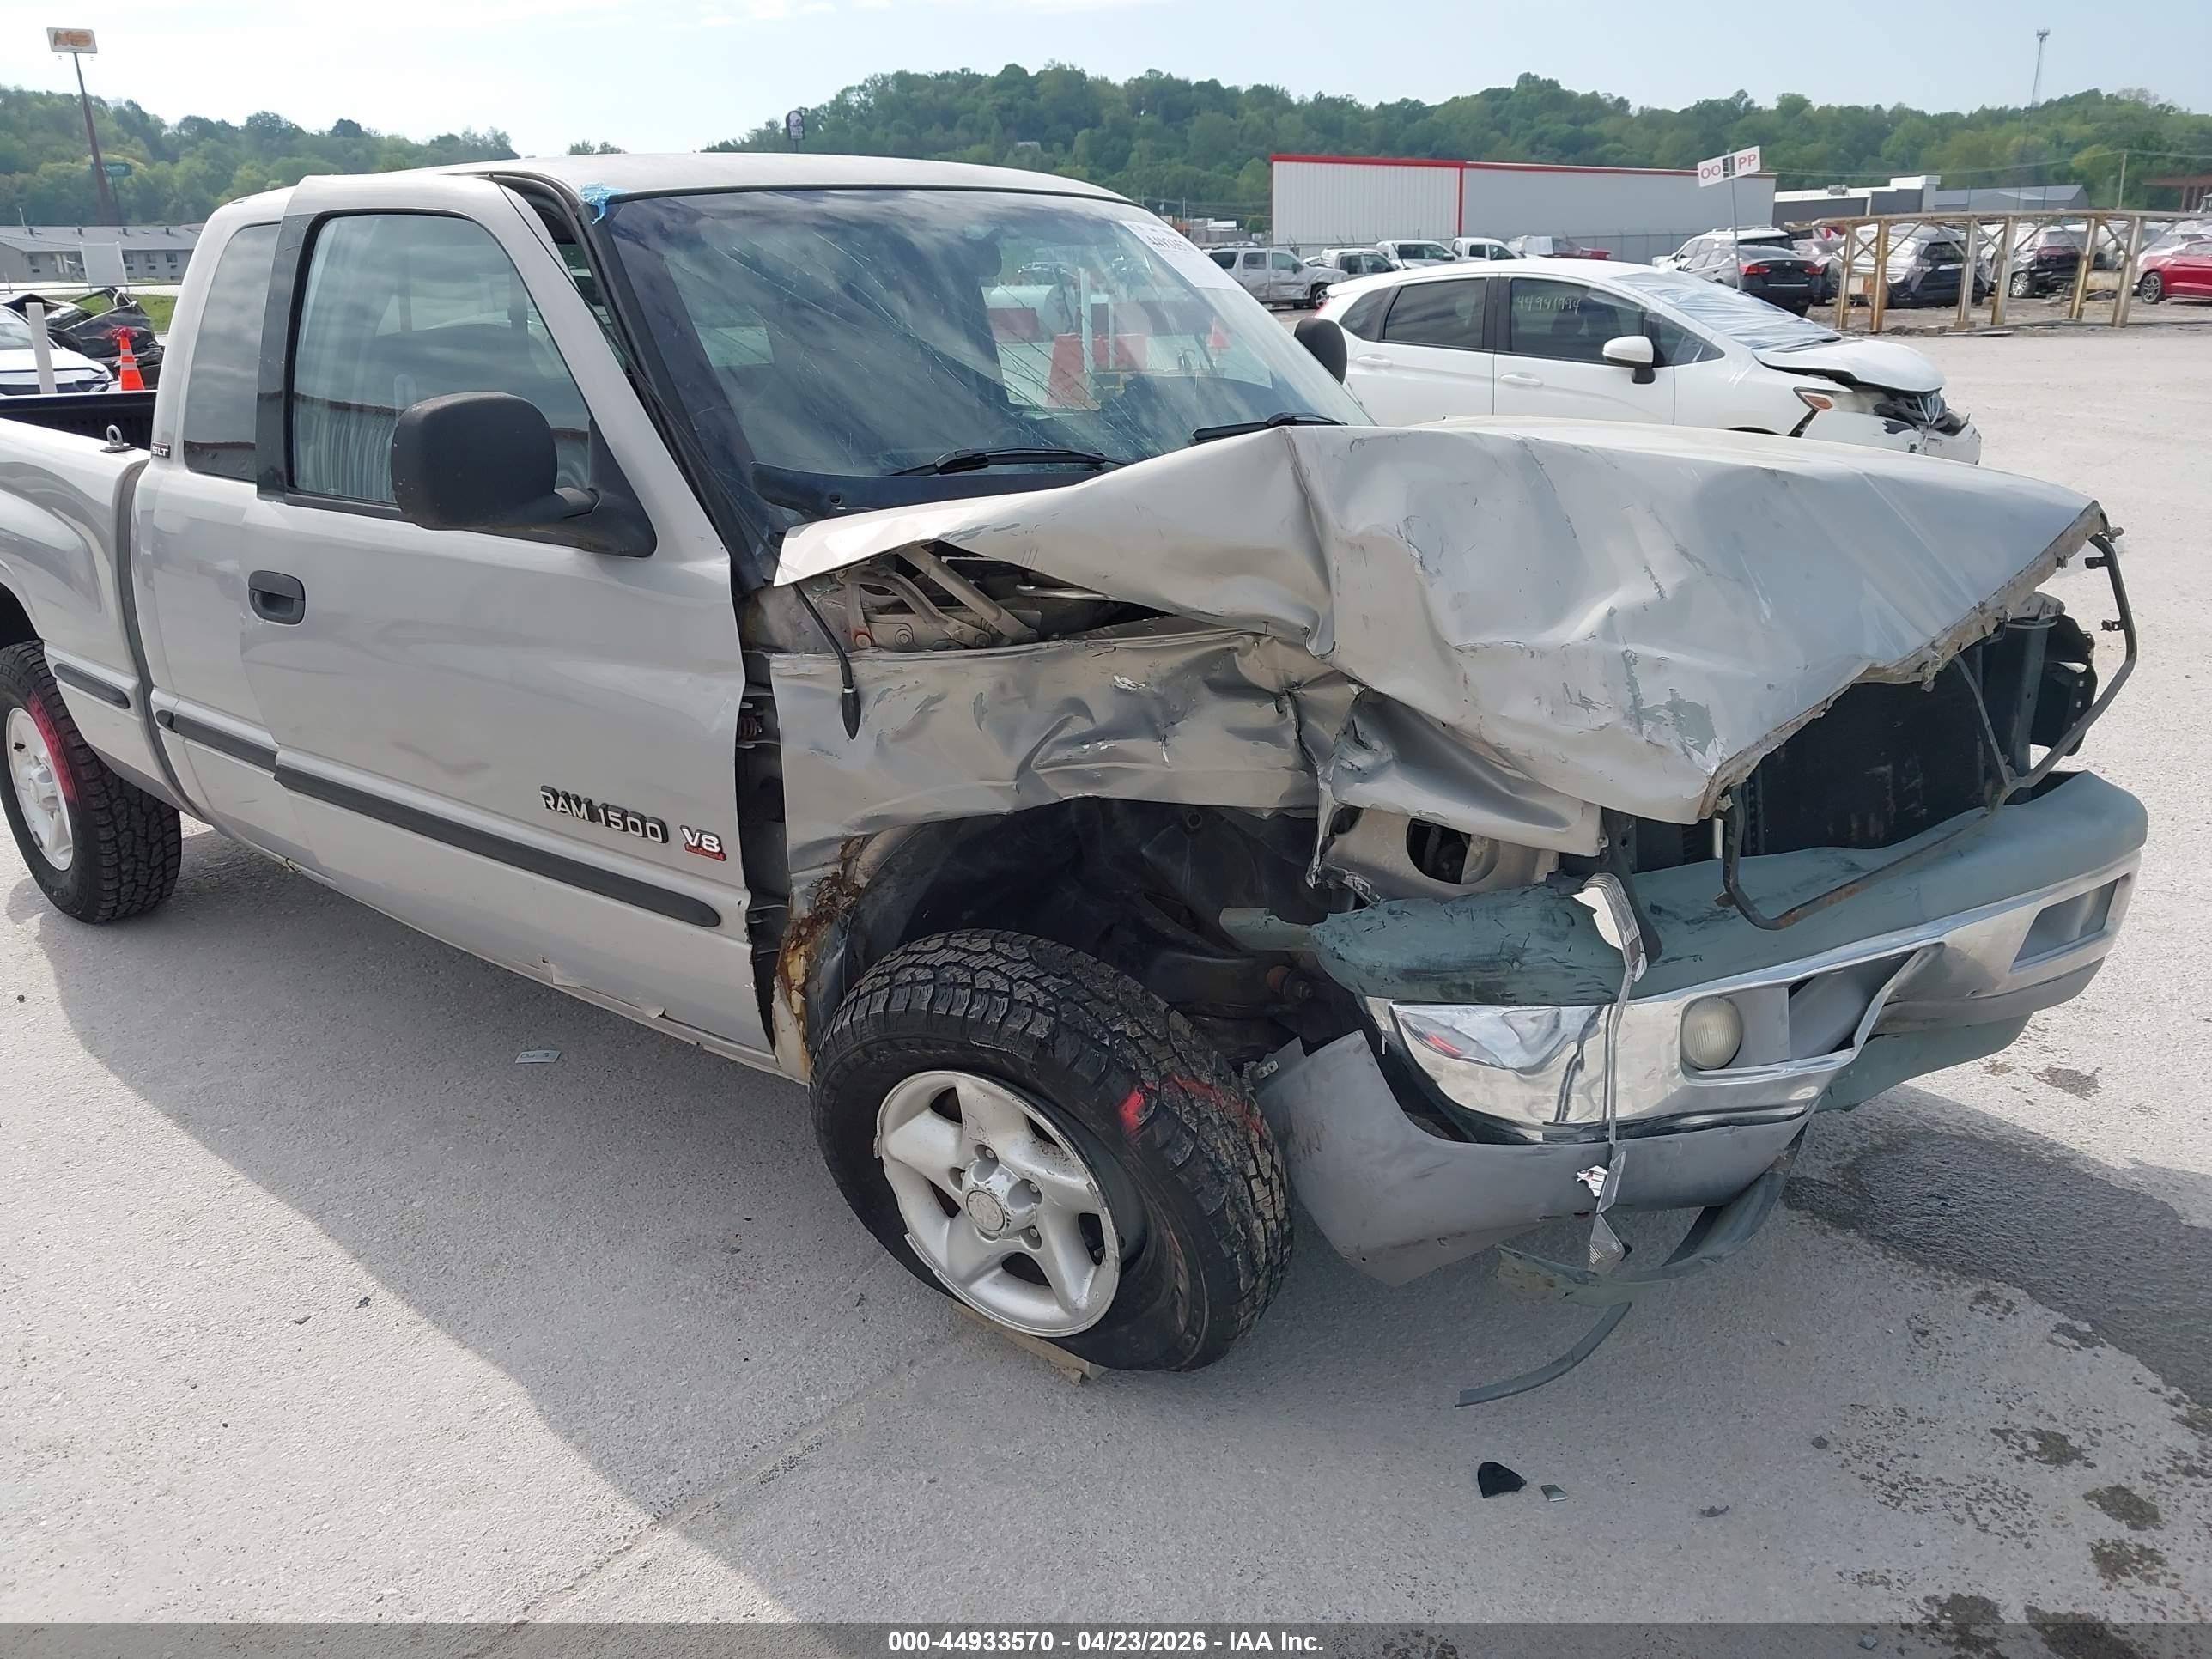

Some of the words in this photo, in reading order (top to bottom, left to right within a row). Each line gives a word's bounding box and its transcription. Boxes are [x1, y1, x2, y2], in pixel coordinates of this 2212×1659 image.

[1700, 164, 1722, 179] OO
[1738, 153, 1757, 170] PP
[151, 445, 169, 457] SLT
[539, 787, 592, 822] RAM
[596, 805, 667, 843] 1500
[680, 826, 723, 853] V8
